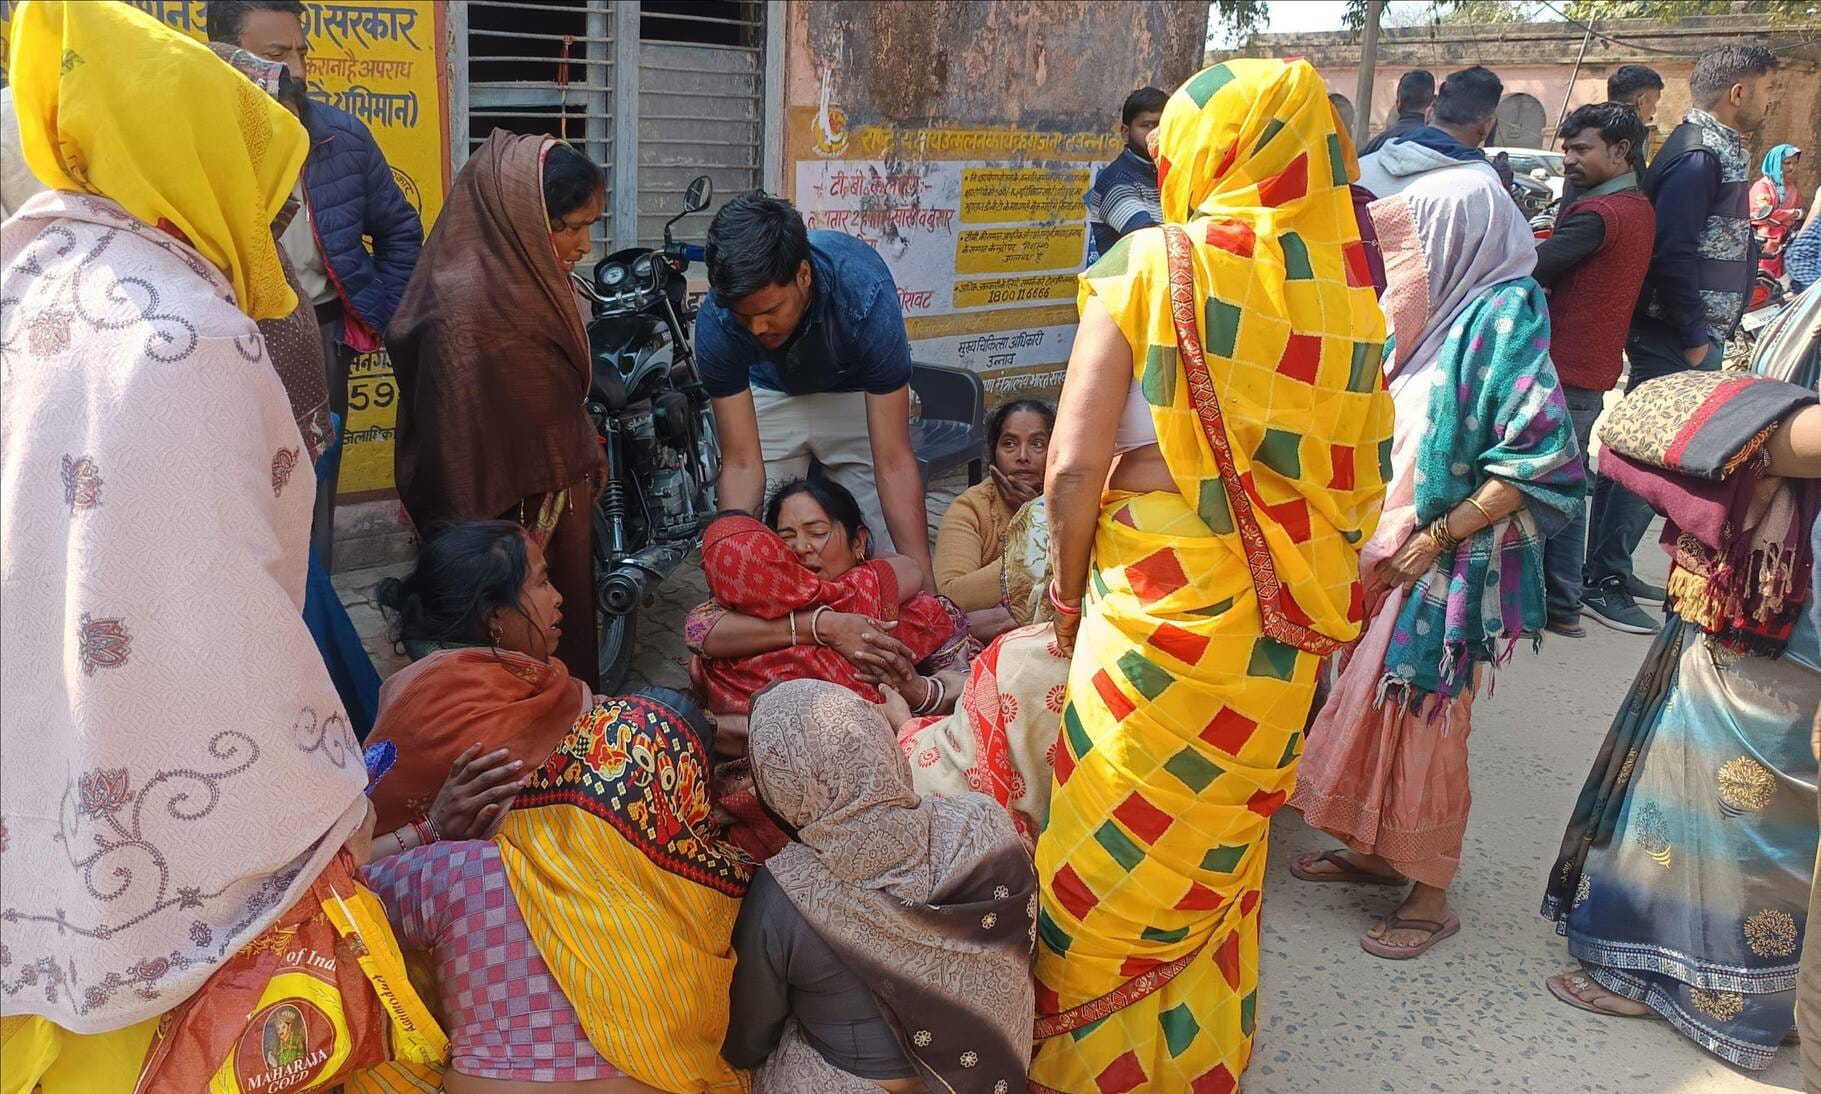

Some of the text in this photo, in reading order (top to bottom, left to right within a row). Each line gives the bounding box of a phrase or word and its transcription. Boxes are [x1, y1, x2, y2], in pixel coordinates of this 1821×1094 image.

[359, 59, 414, 80] अपराध
[286, 948, 307, 966] of
[247, 1048, 328, 1091] MAHARAJA
